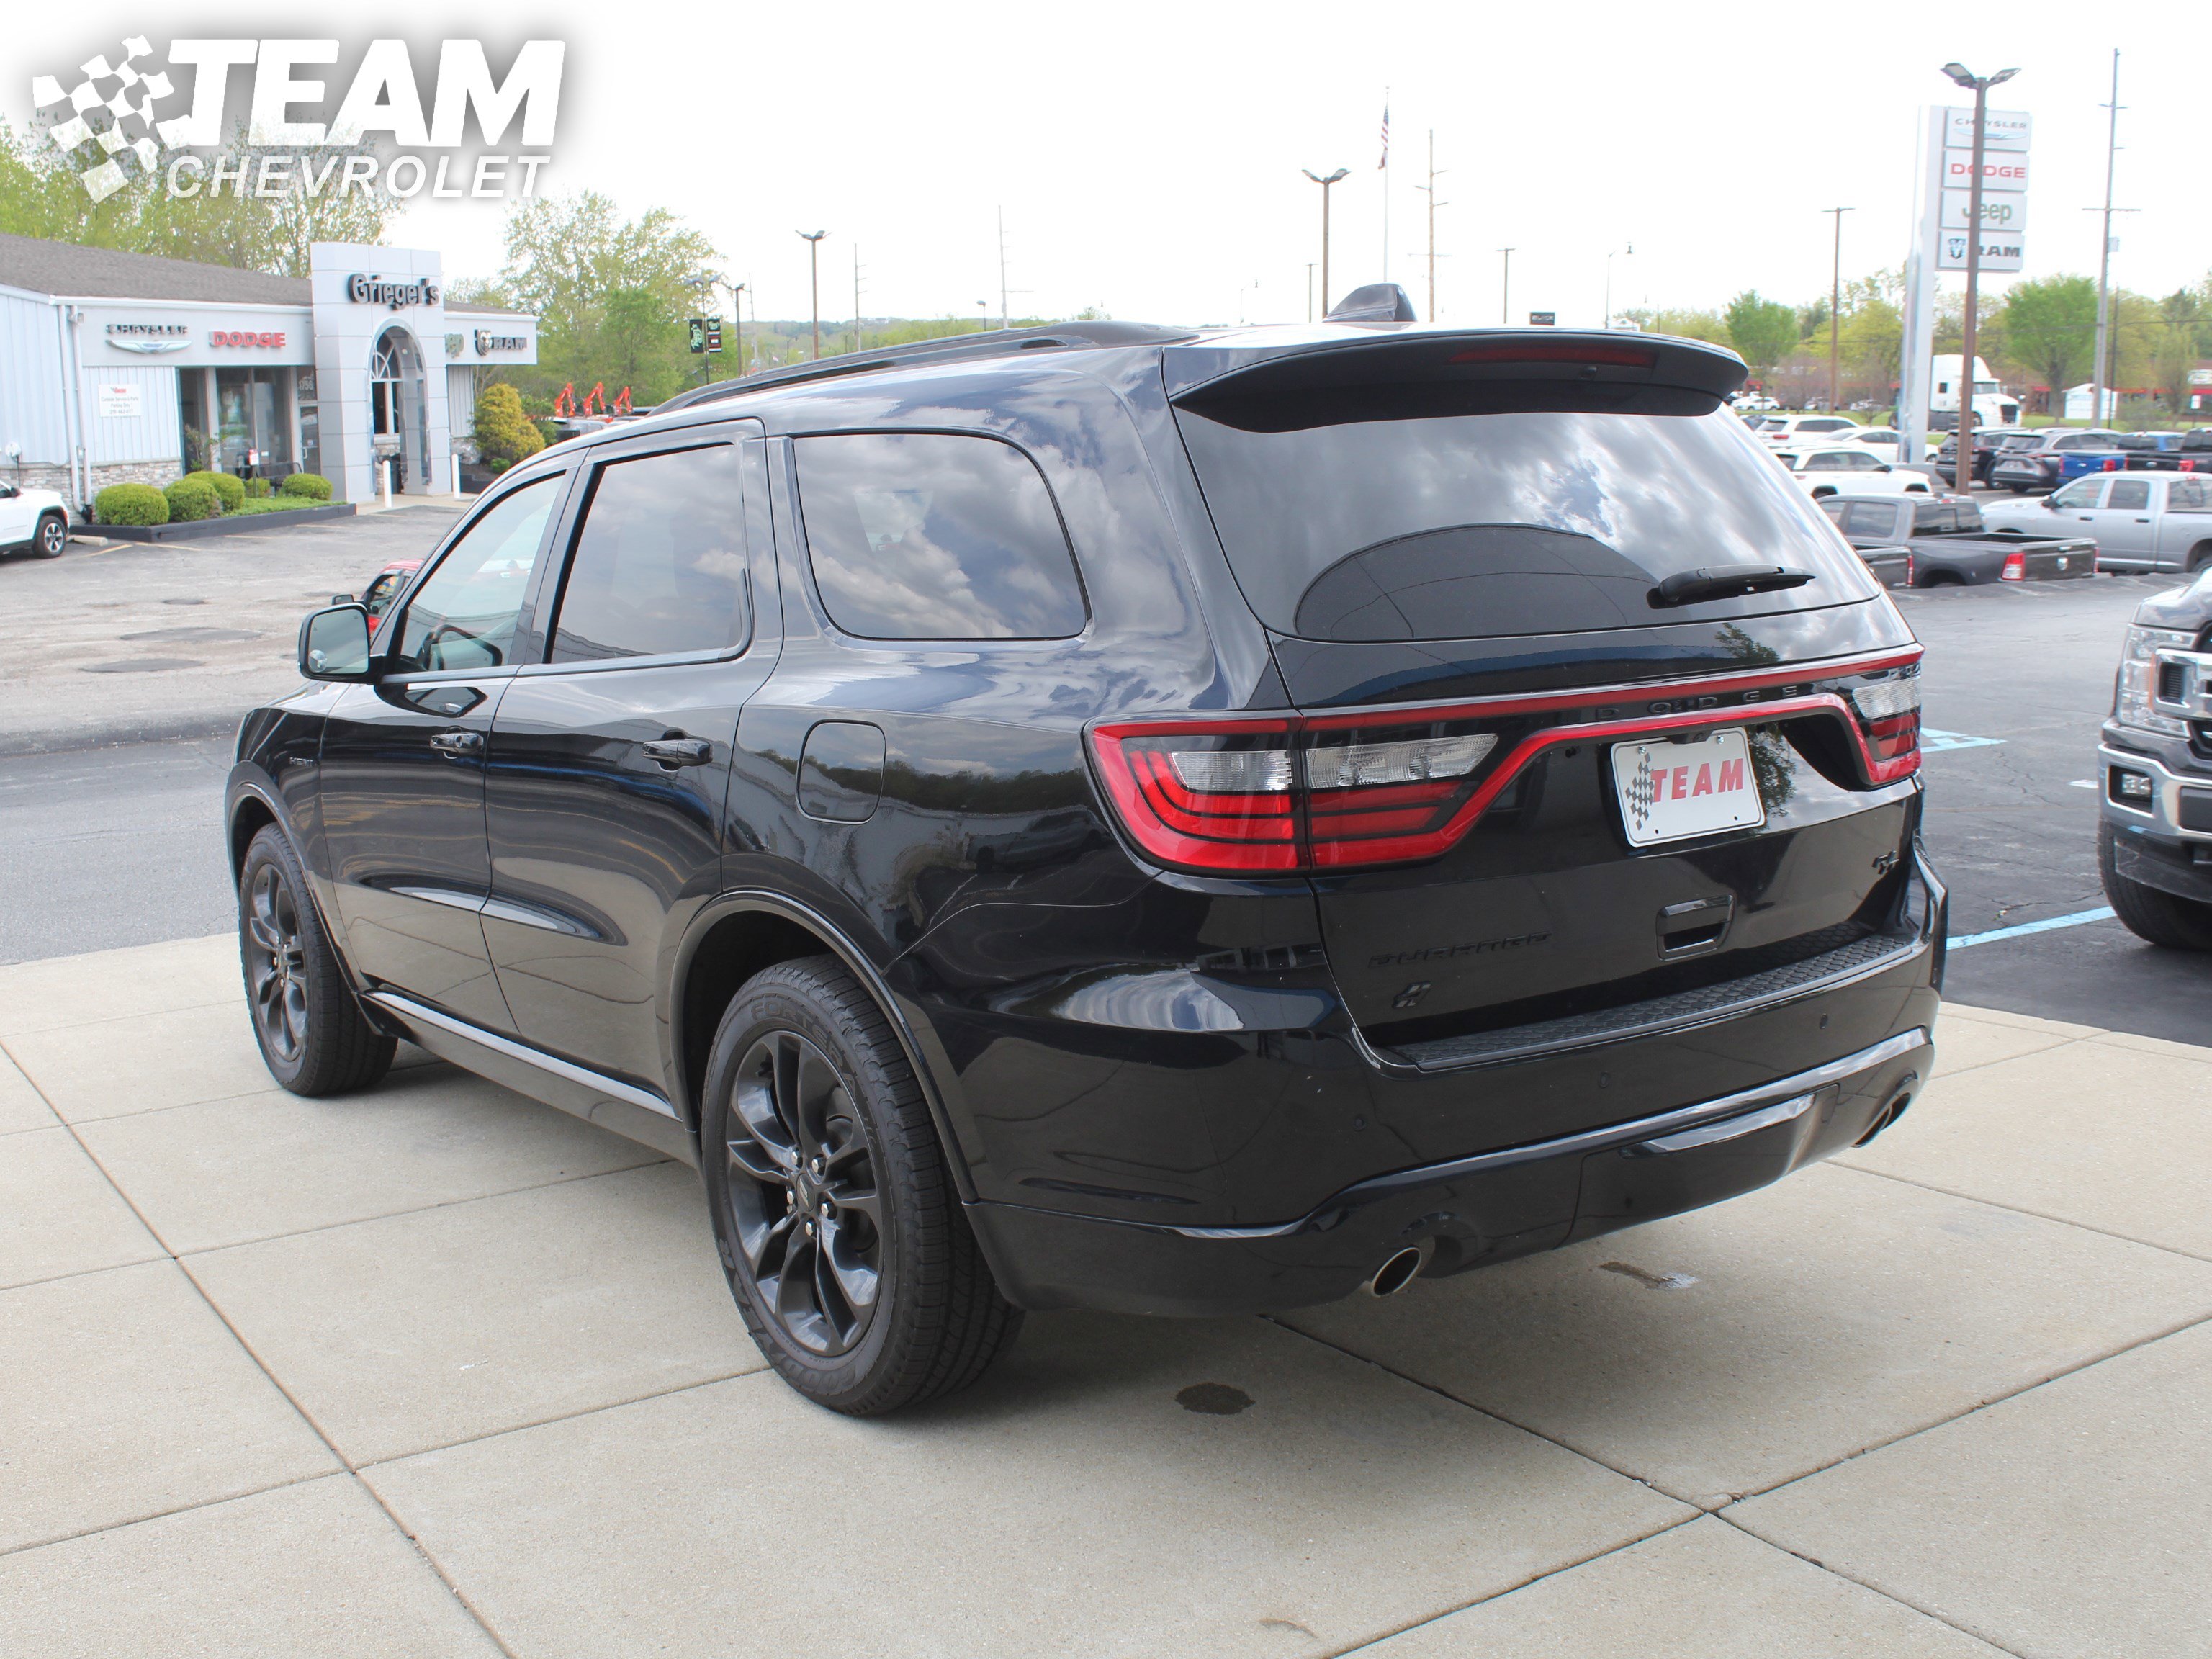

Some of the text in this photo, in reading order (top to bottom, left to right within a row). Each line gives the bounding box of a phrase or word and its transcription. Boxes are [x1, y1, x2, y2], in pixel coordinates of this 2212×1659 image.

[1954, 118, 2027, 129] CHYSLER
[348, 273, 439, 310] Grieger's
[105, 323, 189, 334] CHRYSLER
[210, 331, 286, 347] DODGE
[491, 336, 527, 349] RAM
[1596, 685, 1799, 720] DODGE
[1650, 758, 1743, 803] TEAM
[1367, 931, 1552, 968] DURANGO
